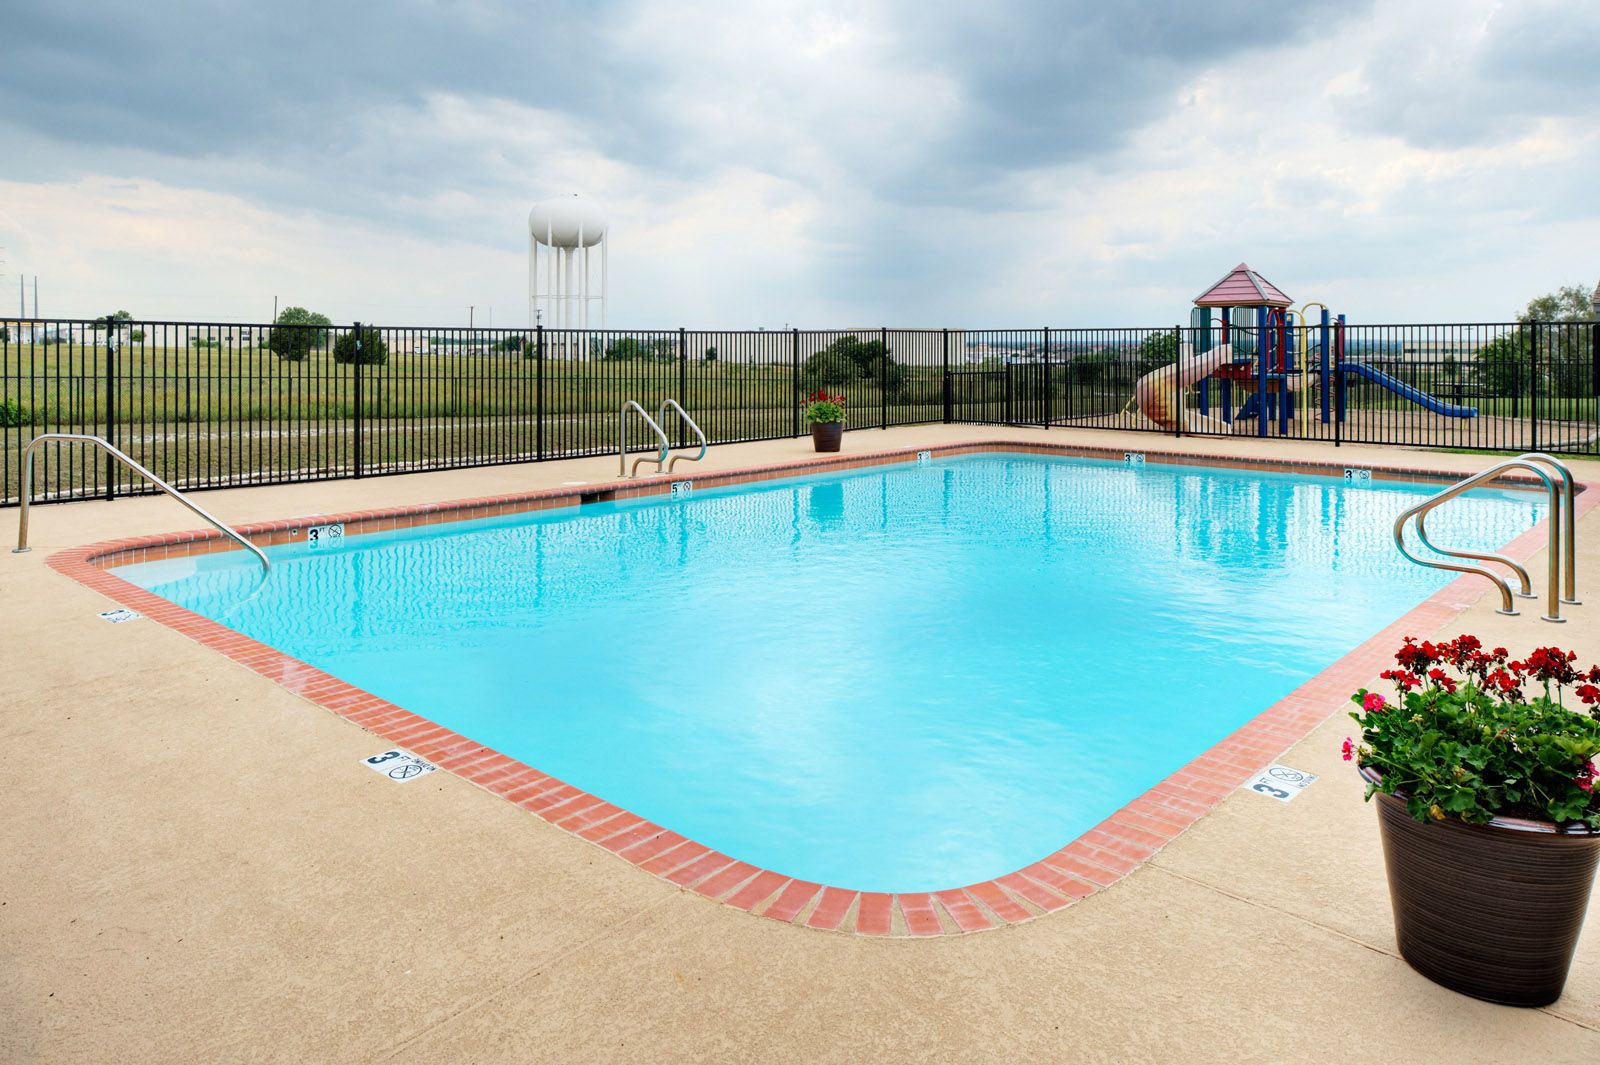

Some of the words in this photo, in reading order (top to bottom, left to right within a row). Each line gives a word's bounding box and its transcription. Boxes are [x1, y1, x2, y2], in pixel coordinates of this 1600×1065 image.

[309, 528, 319, 542] 3
[367, 751, 401, 764] 3
[1252, 783, 1290, 799] 3
